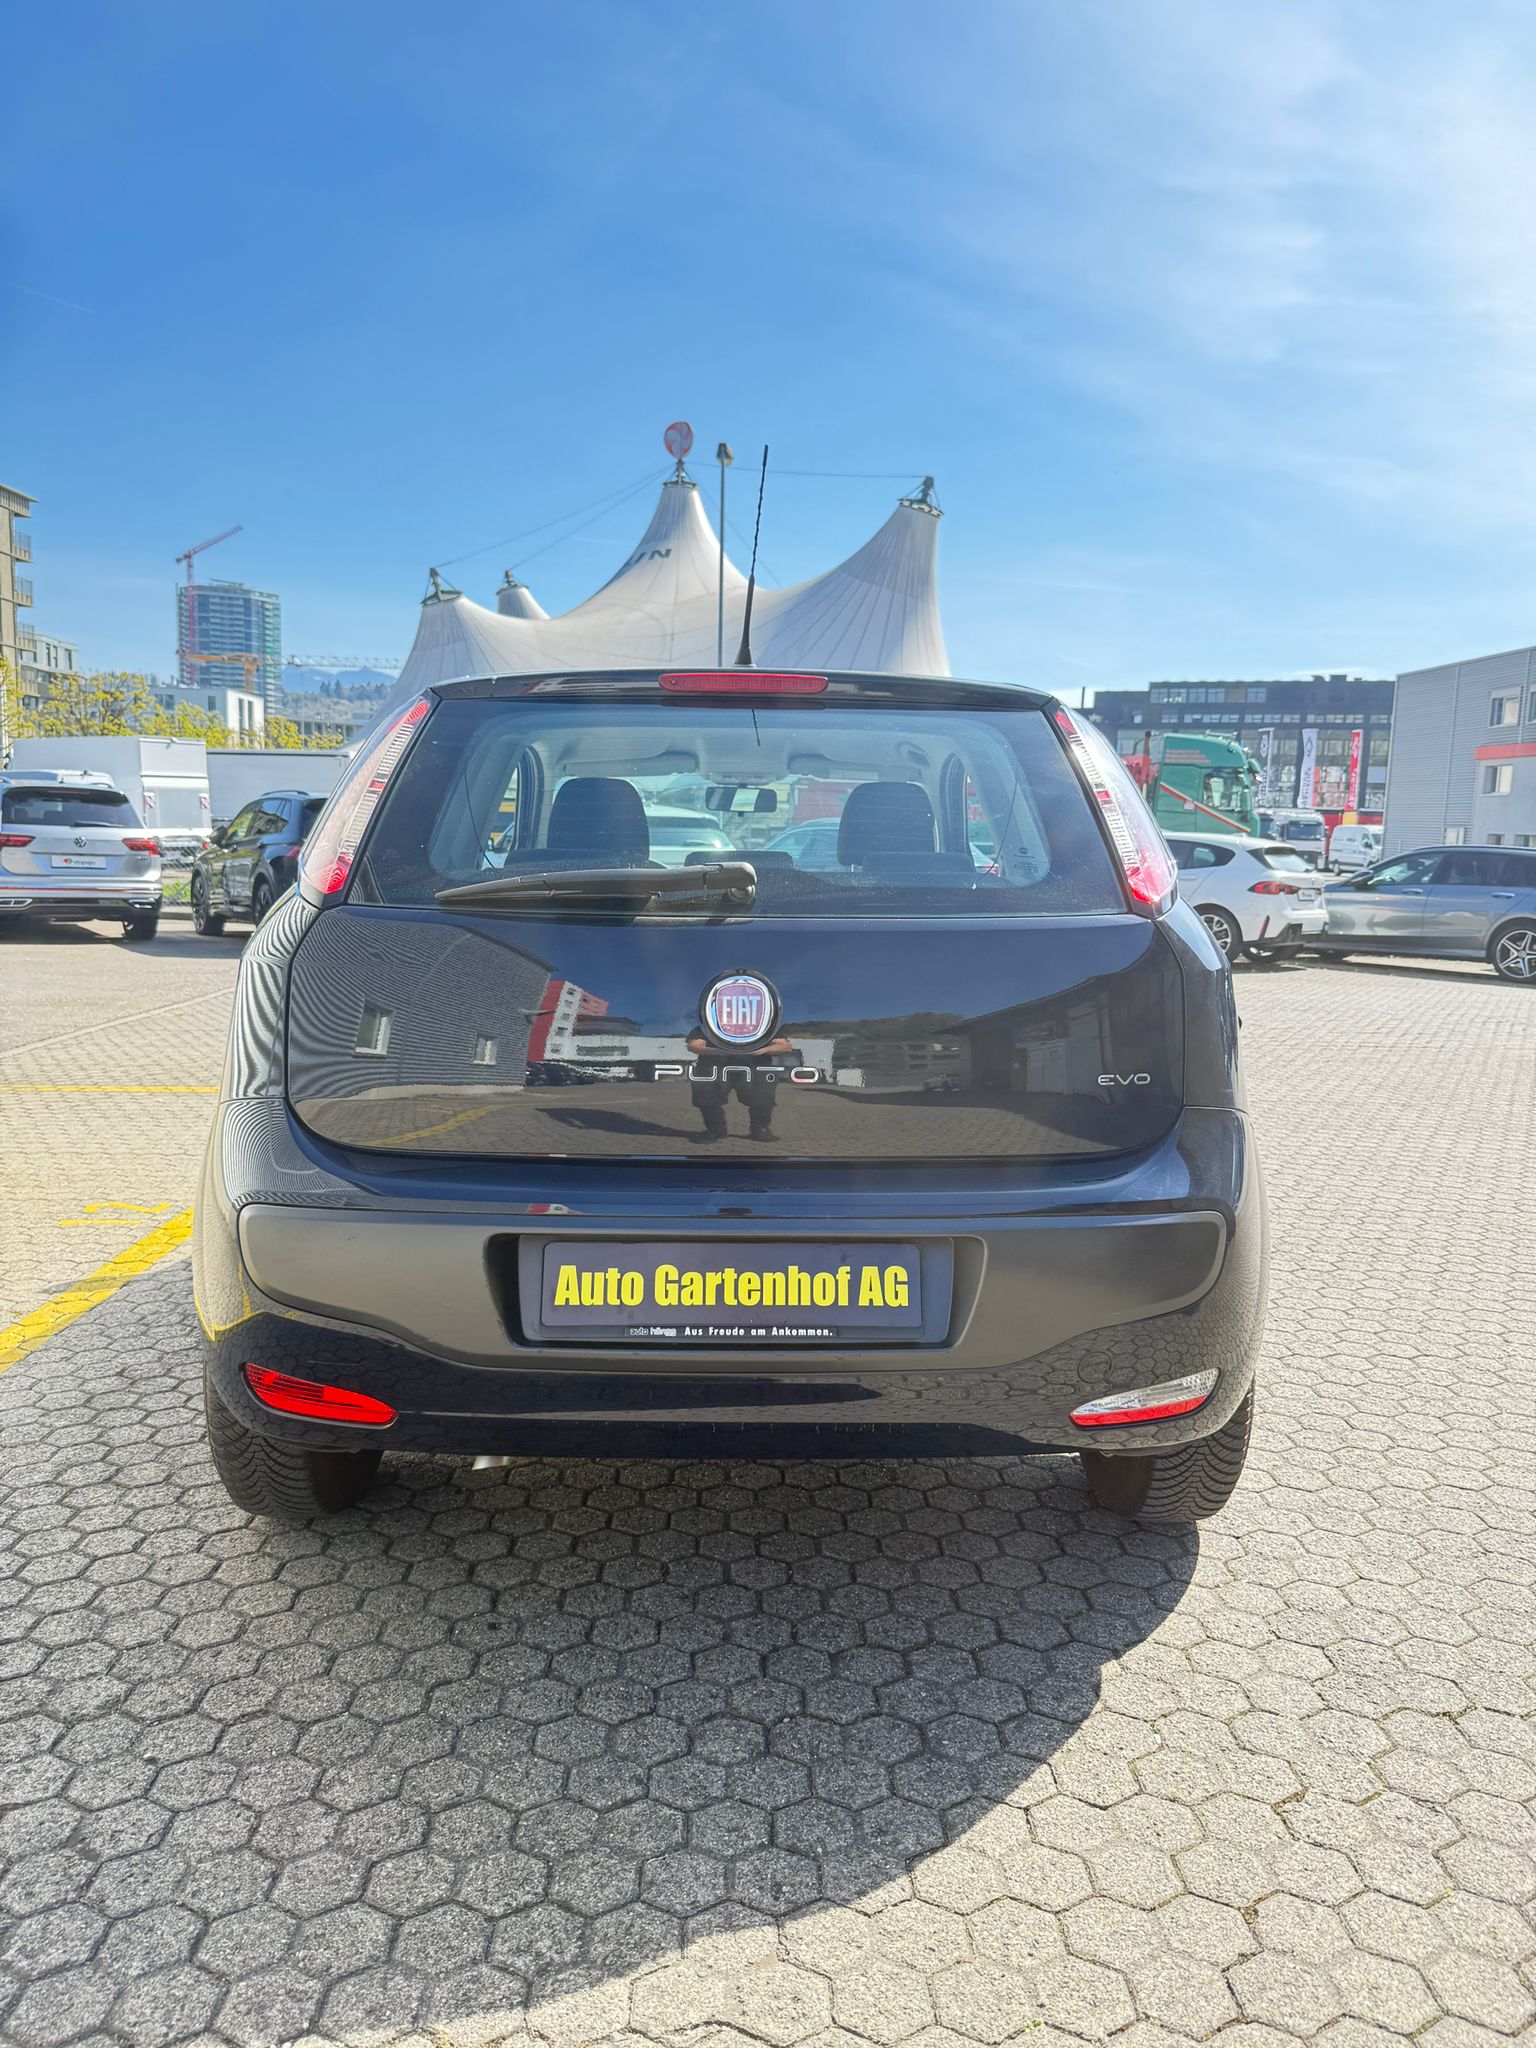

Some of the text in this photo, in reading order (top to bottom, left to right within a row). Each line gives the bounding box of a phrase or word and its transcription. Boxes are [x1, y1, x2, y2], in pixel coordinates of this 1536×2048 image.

[722, 994, 761, 1025] FIAT
[654, 1064, 820, 1083] PUNTO
[1097, 1073, 1151, 1085] EVO
[554, 1264, 910, 1307] Auto Gartenhof AG
[684, 1326, 704, 1336] Aus
[708, 1326, 746, 1336] Freude
[750, 1326, 767, 1336] am
[771, 1326, 834, 1336] Ankommen.
